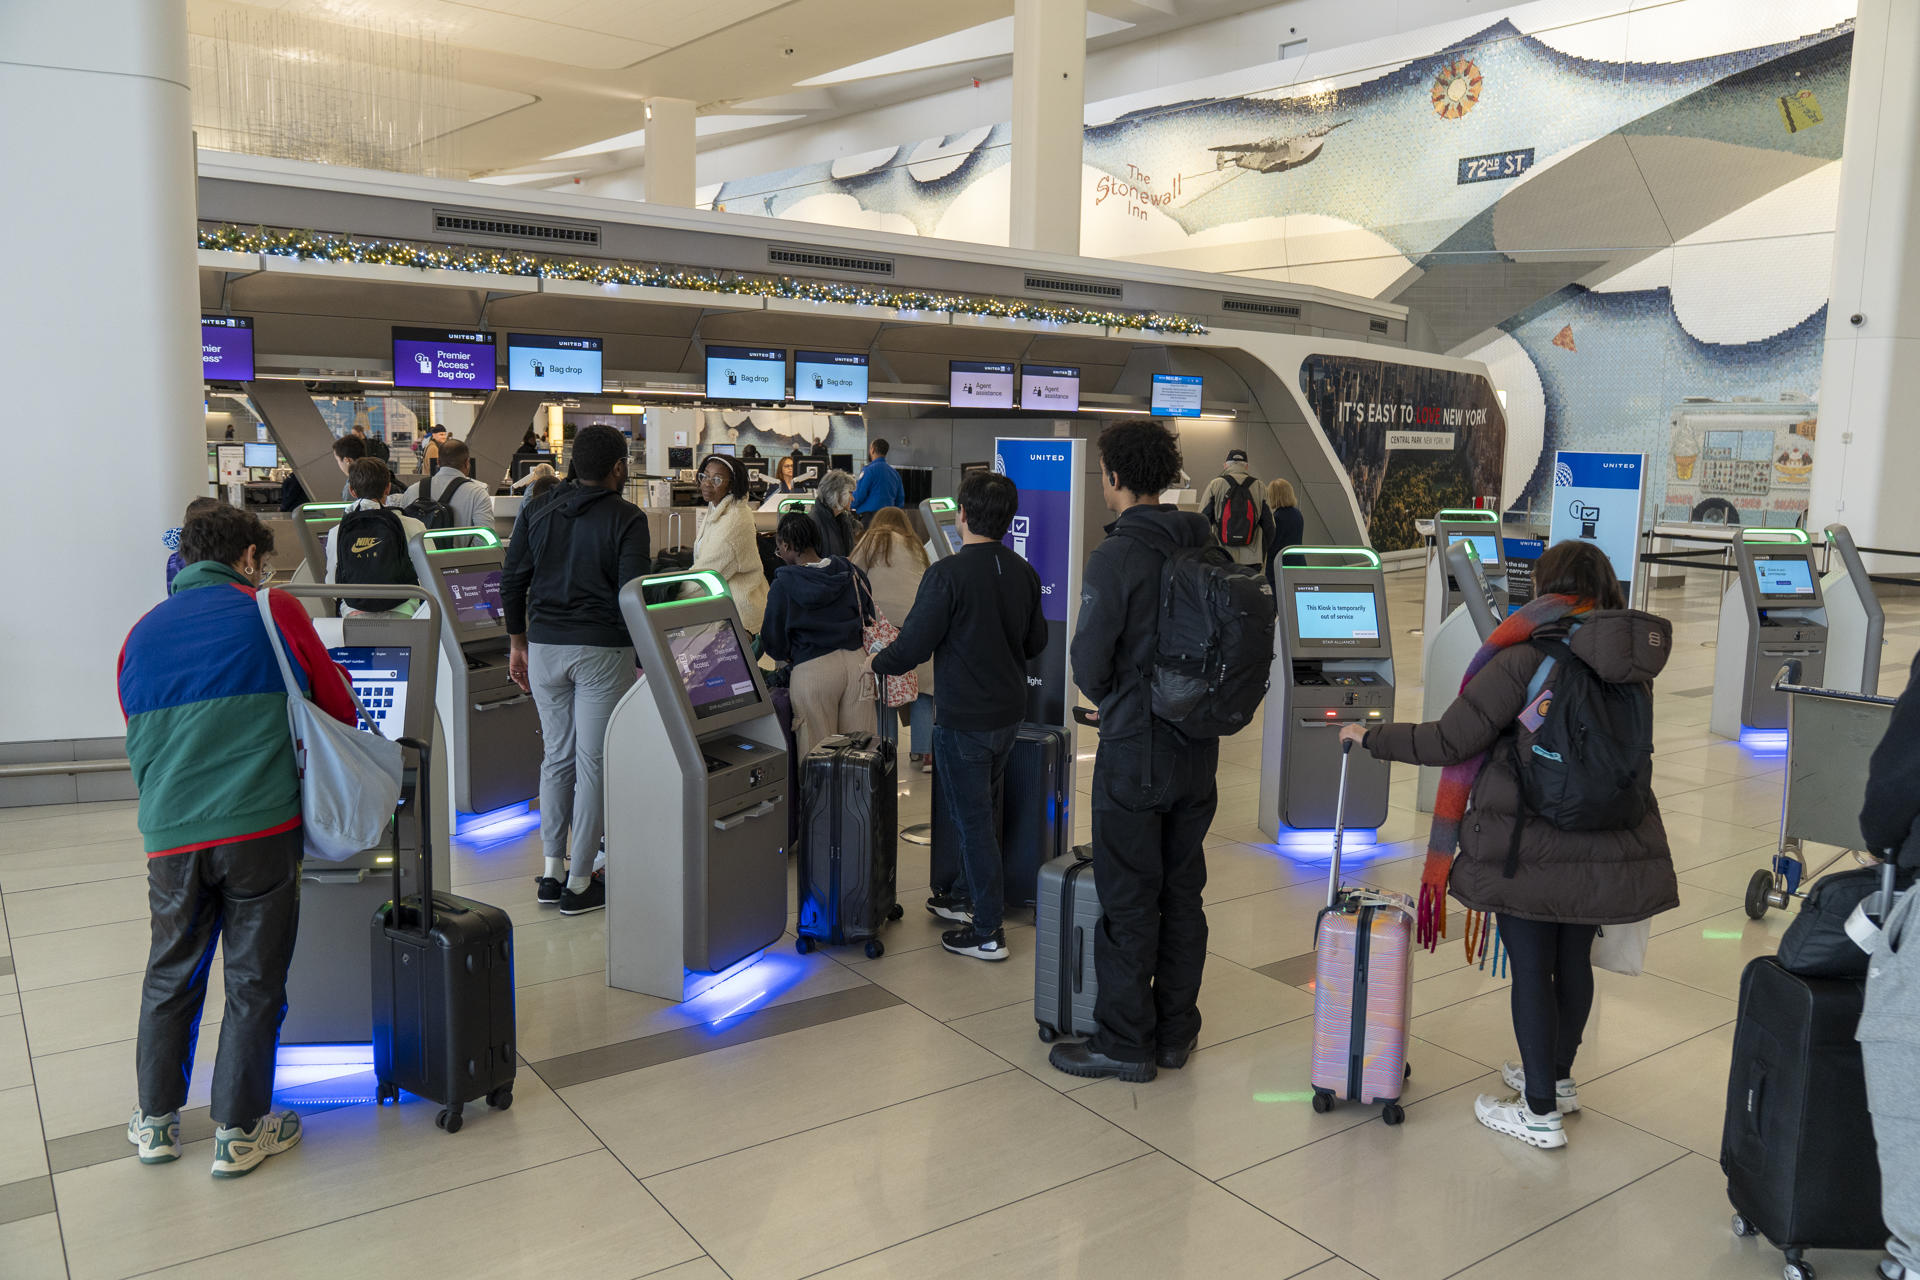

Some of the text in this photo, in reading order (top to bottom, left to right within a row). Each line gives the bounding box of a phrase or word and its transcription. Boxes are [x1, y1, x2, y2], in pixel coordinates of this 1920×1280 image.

[1127, 163, 1151, 185] The
[1095, 172, 1182, 207] Stonewall
[1127, 200, 1148, 221] Inn
[437, 350, 471, 361] Premier
[437, 369, 476, 381] bag drop
[549, 364, 583, 376] Bag drop
[741, 374, 769, 384] Bag drop
[827, 379, 853, 388] Bag drop
[975, 382, 992, 390] Agent
[1044, 385, 1060, 393] Agent
[1338, 401, 1488, 427] IT'S EASY TO LOVE NEW YORK
[1390, 435, 1410, 445] CENTRAL
[1411, 436, 1423, 445] PARK
[1423, 437, 1433, 445] NEW
[1318, 604, 1331, 612] Kiosk
[1337, 604, 1366, 613] temporarily
[1337, 613, 1354, 621] service
